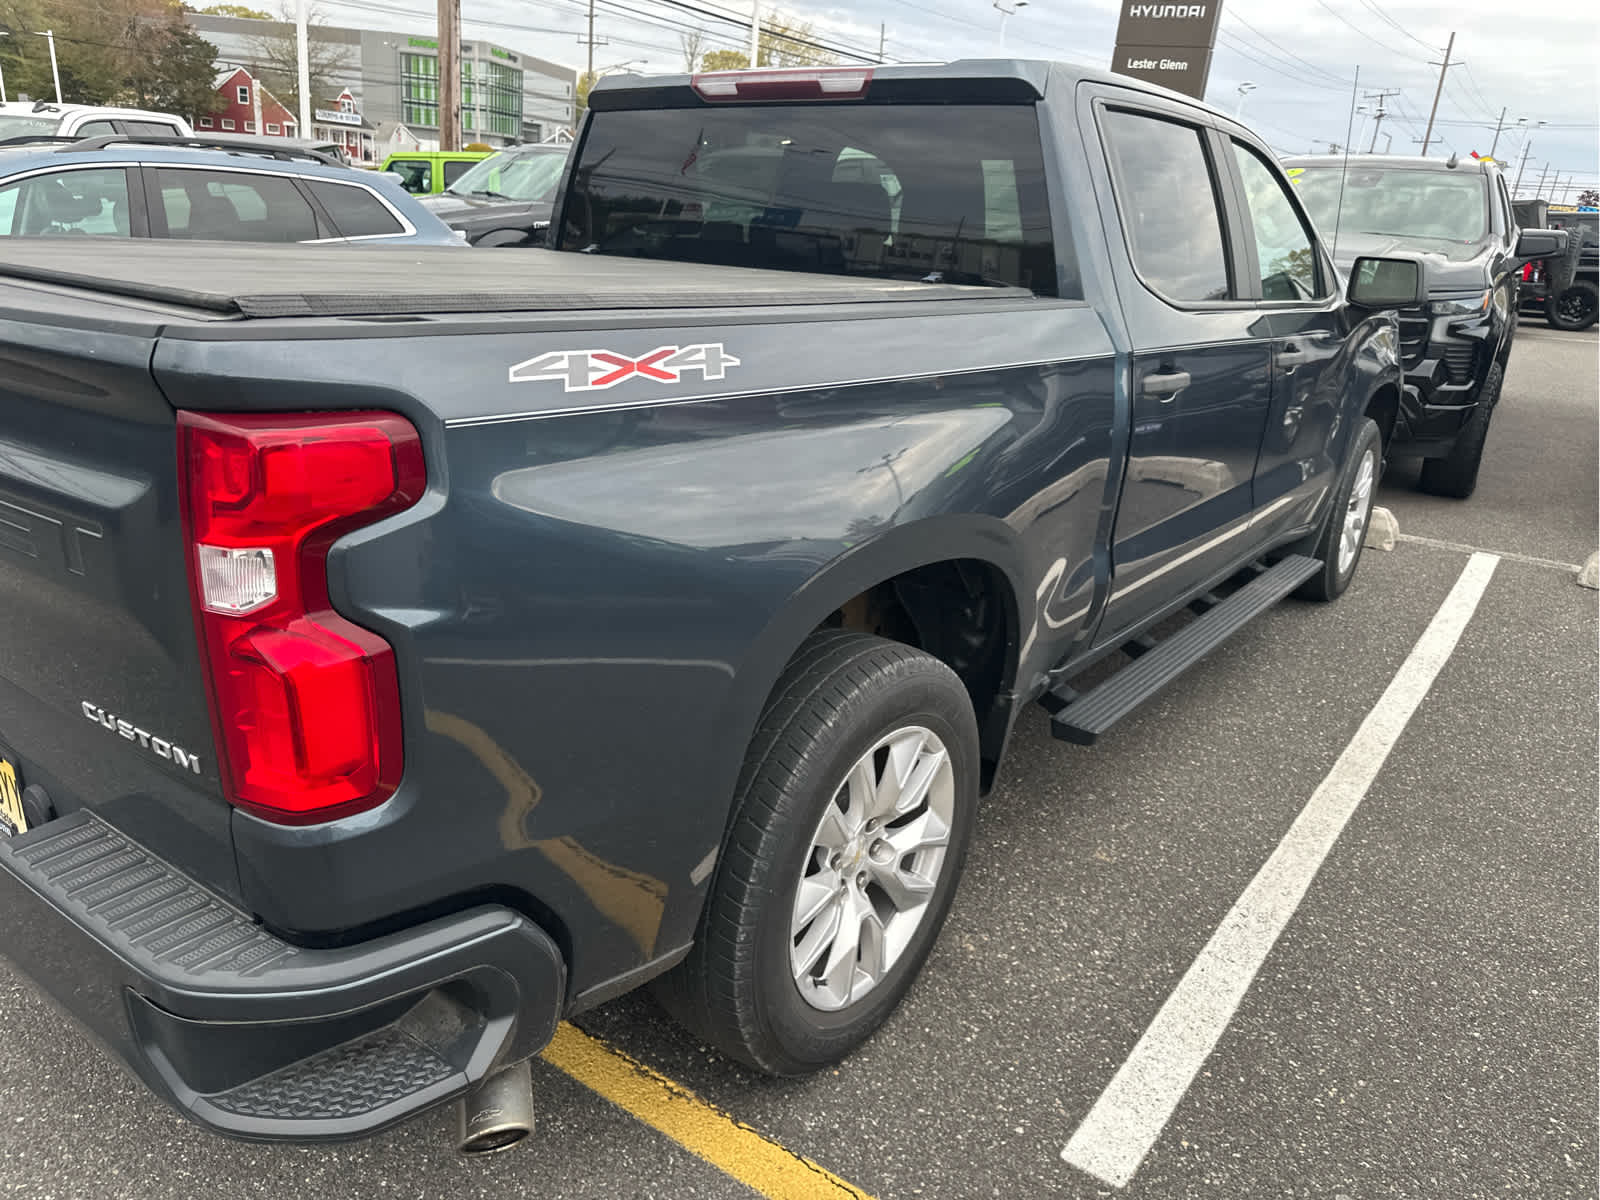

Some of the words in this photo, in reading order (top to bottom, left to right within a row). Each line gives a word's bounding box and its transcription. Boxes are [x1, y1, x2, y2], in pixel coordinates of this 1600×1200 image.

[1129, 5, 1206, 19] HYUNDAI
[1127, 58, 1158, 70] Lester
[1159, 59, 1188, 71] Glenn
[81, 700, 201, 774] CUSTOM
